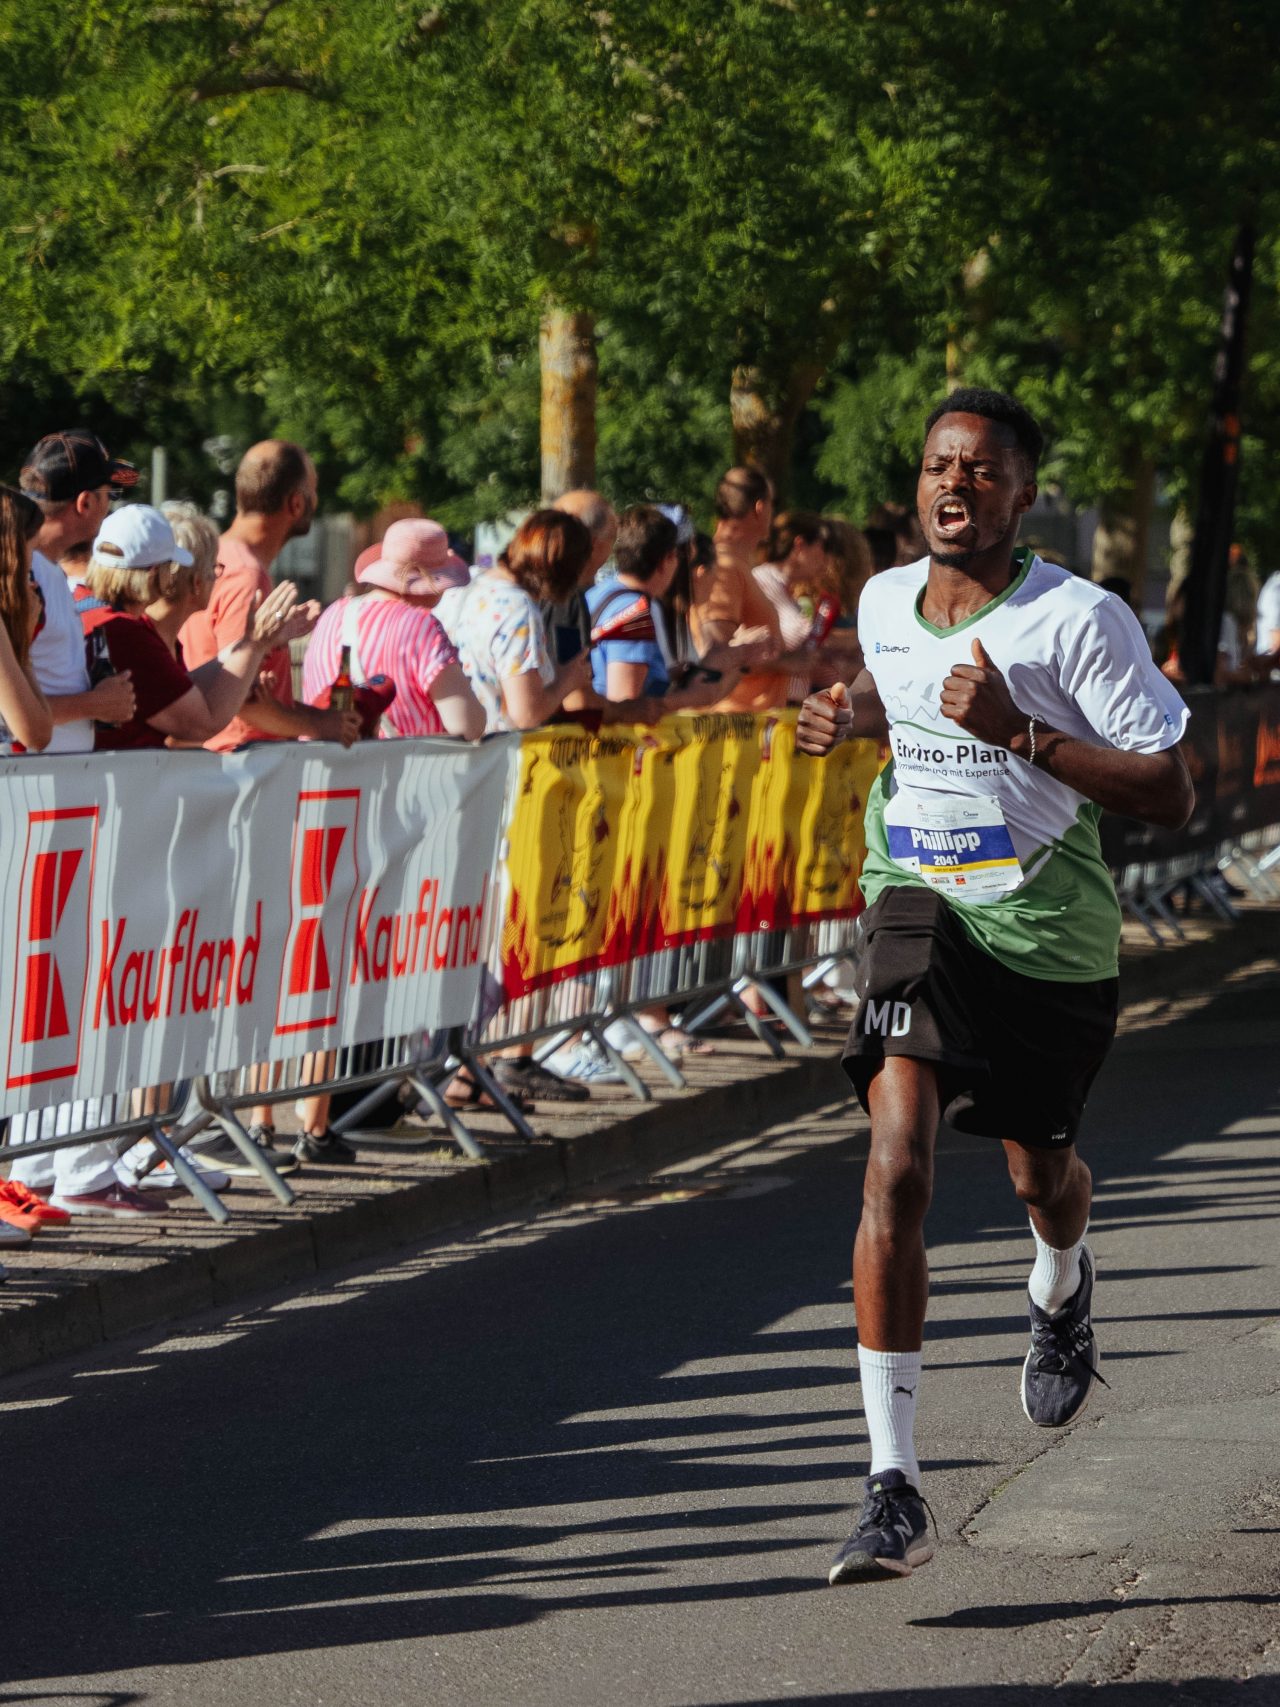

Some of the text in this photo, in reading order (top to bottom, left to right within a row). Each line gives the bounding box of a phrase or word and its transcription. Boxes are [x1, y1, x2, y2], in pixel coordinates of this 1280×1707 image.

[950, 768, 964, 778] mit
[965, 767, 1011, 779] Expertise
[910, 828, 981, 854] Phillipp
[933, 854, 960, 867] 2041
[350, 872, 489, 986] Kaufland
[92, 900, 264, 1031] Kaufland
[864, 999, 912, 1037] MD
